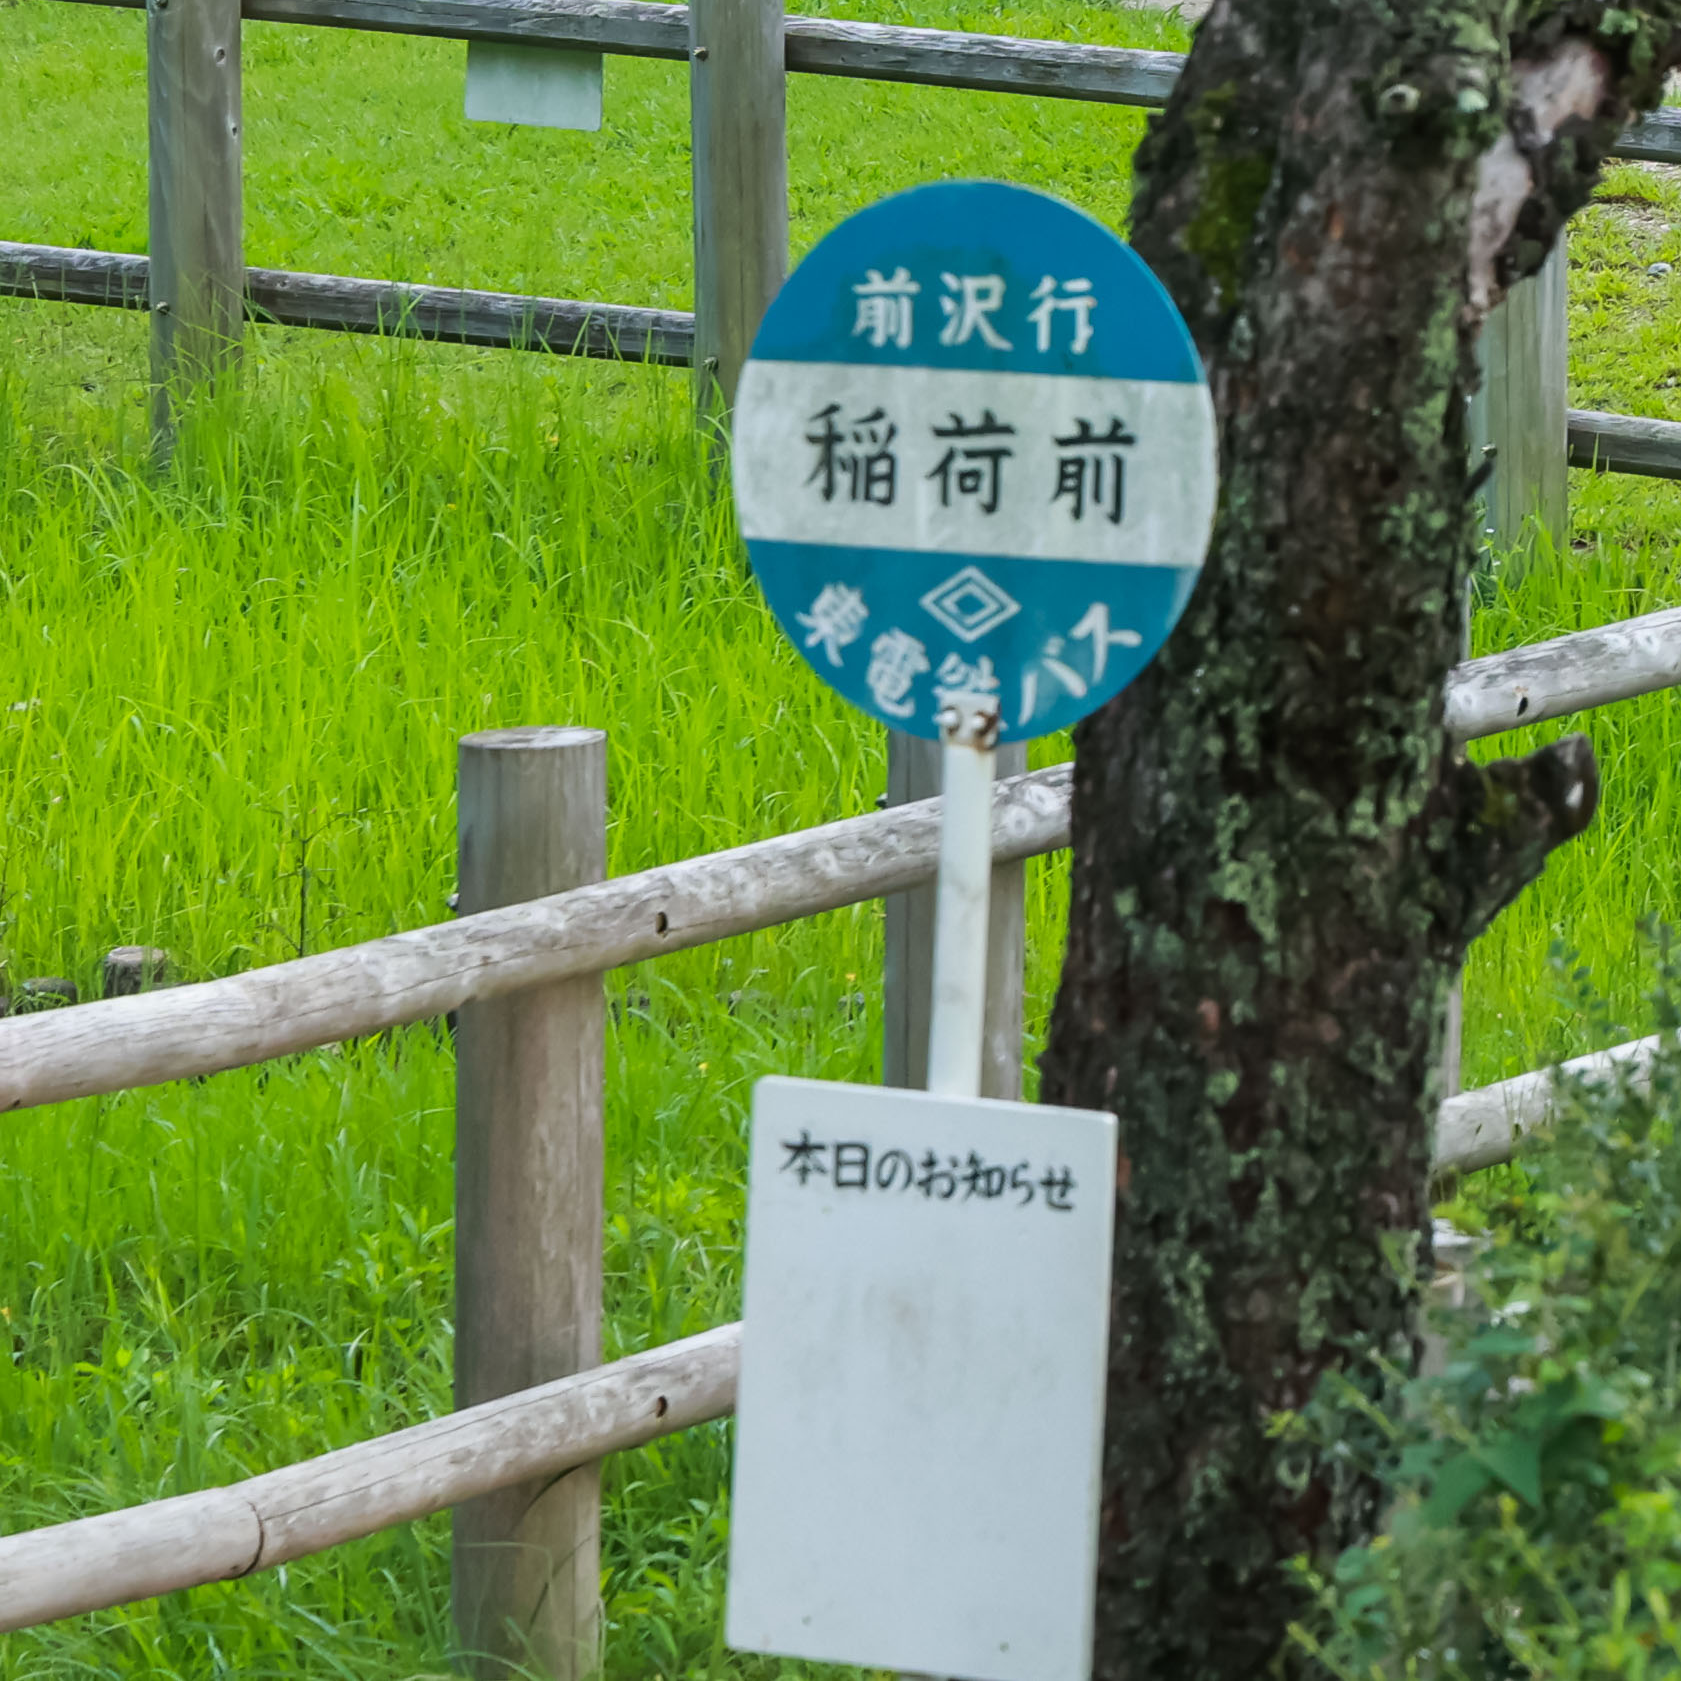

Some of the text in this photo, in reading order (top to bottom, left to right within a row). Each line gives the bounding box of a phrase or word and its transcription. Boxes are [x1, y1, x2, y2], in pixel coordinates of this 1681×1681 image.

[851, 265, 1097, 355] 前沢行
[804, 402, 1136, 525] 稲荷前
[779, 1128, 1078, 1212] 本日のお知らせ
